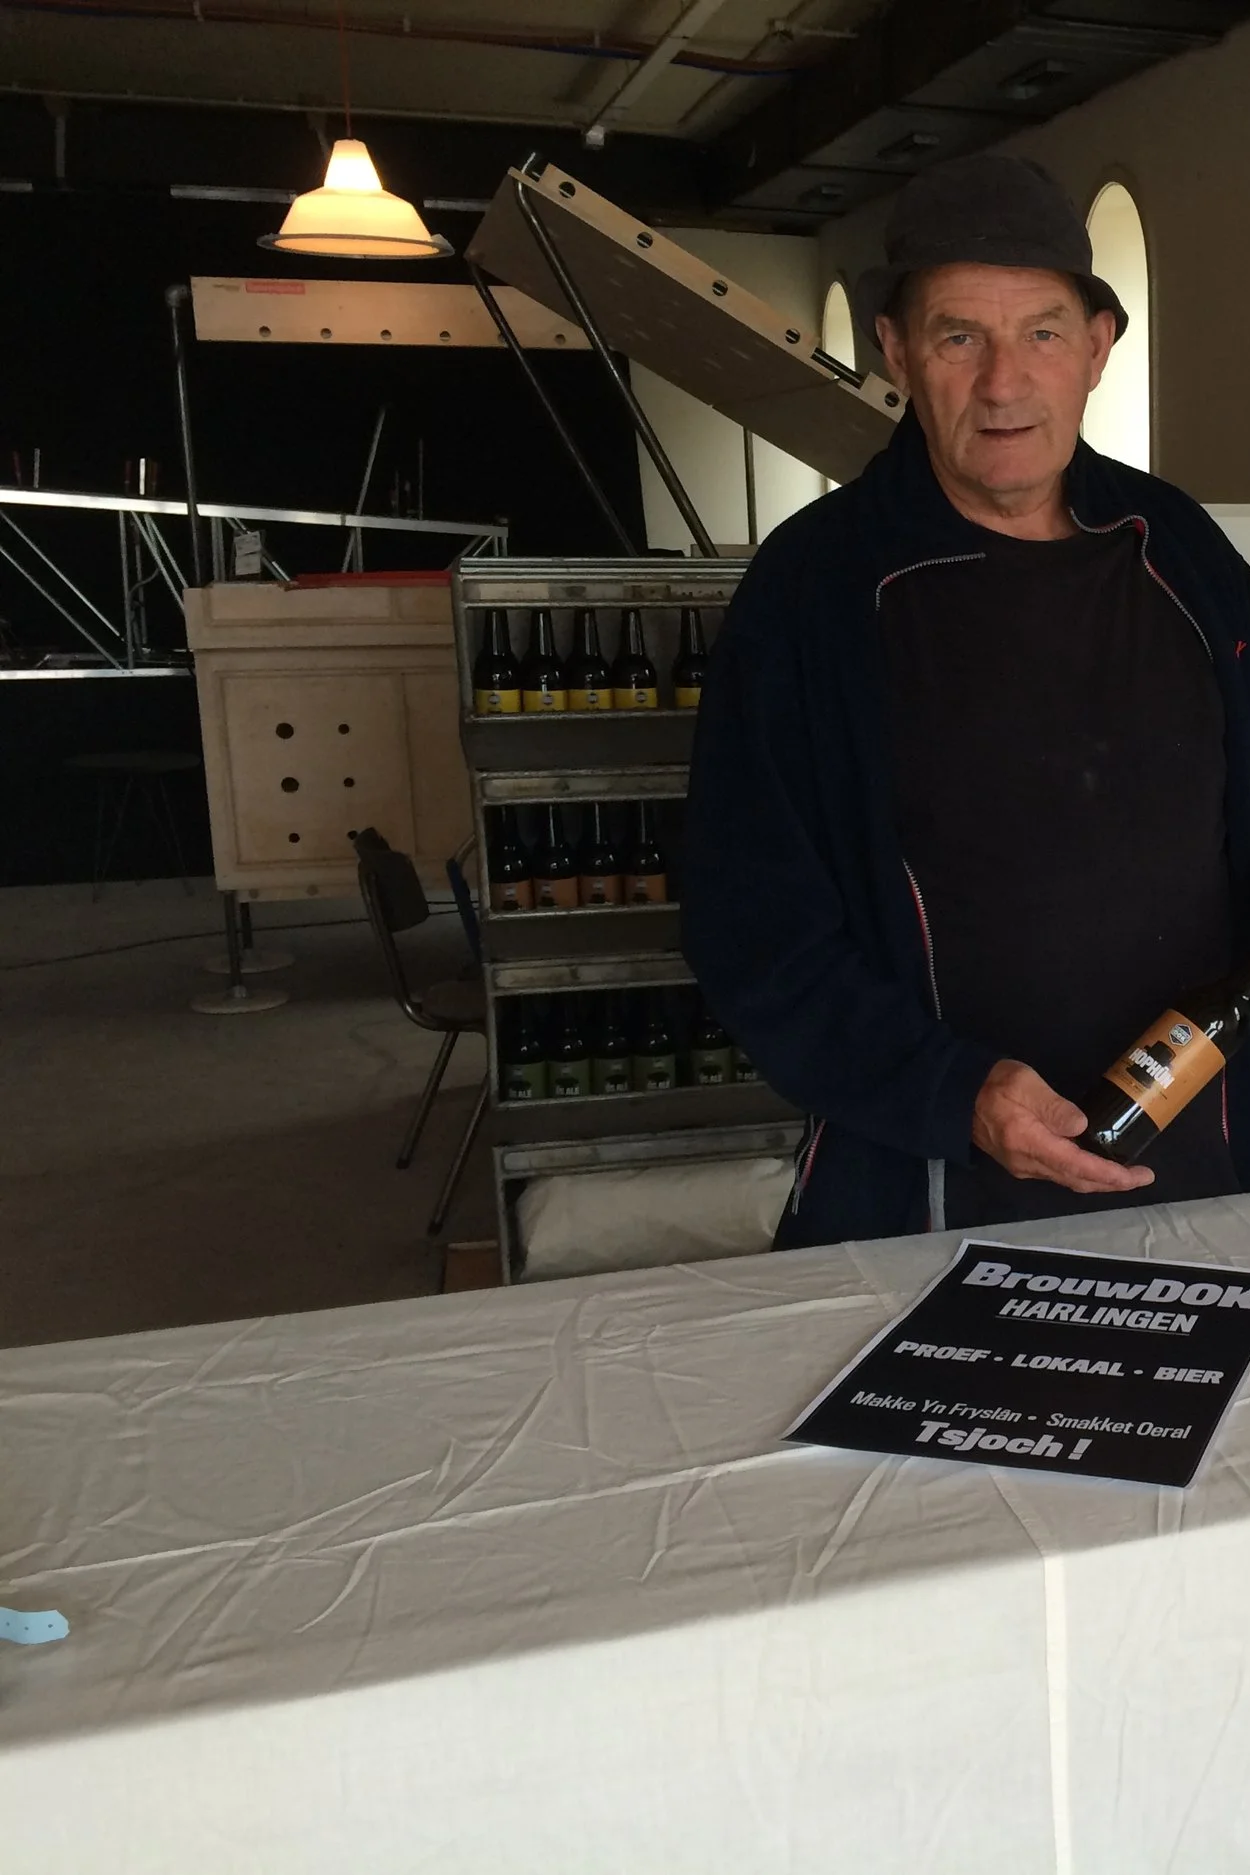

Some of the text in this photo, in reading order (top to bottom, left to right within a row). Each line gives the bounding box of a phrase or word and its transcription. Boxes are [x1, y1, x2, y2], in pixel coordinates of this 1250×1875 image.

[999, 1298, 1199, 1334] HARLINGEN
[893, 1340, 1225, 1385] PROEF LOKAAL BIER
[850, 1390, 1193, 1440] Makke Yn Fryslân Smakket Oeral
